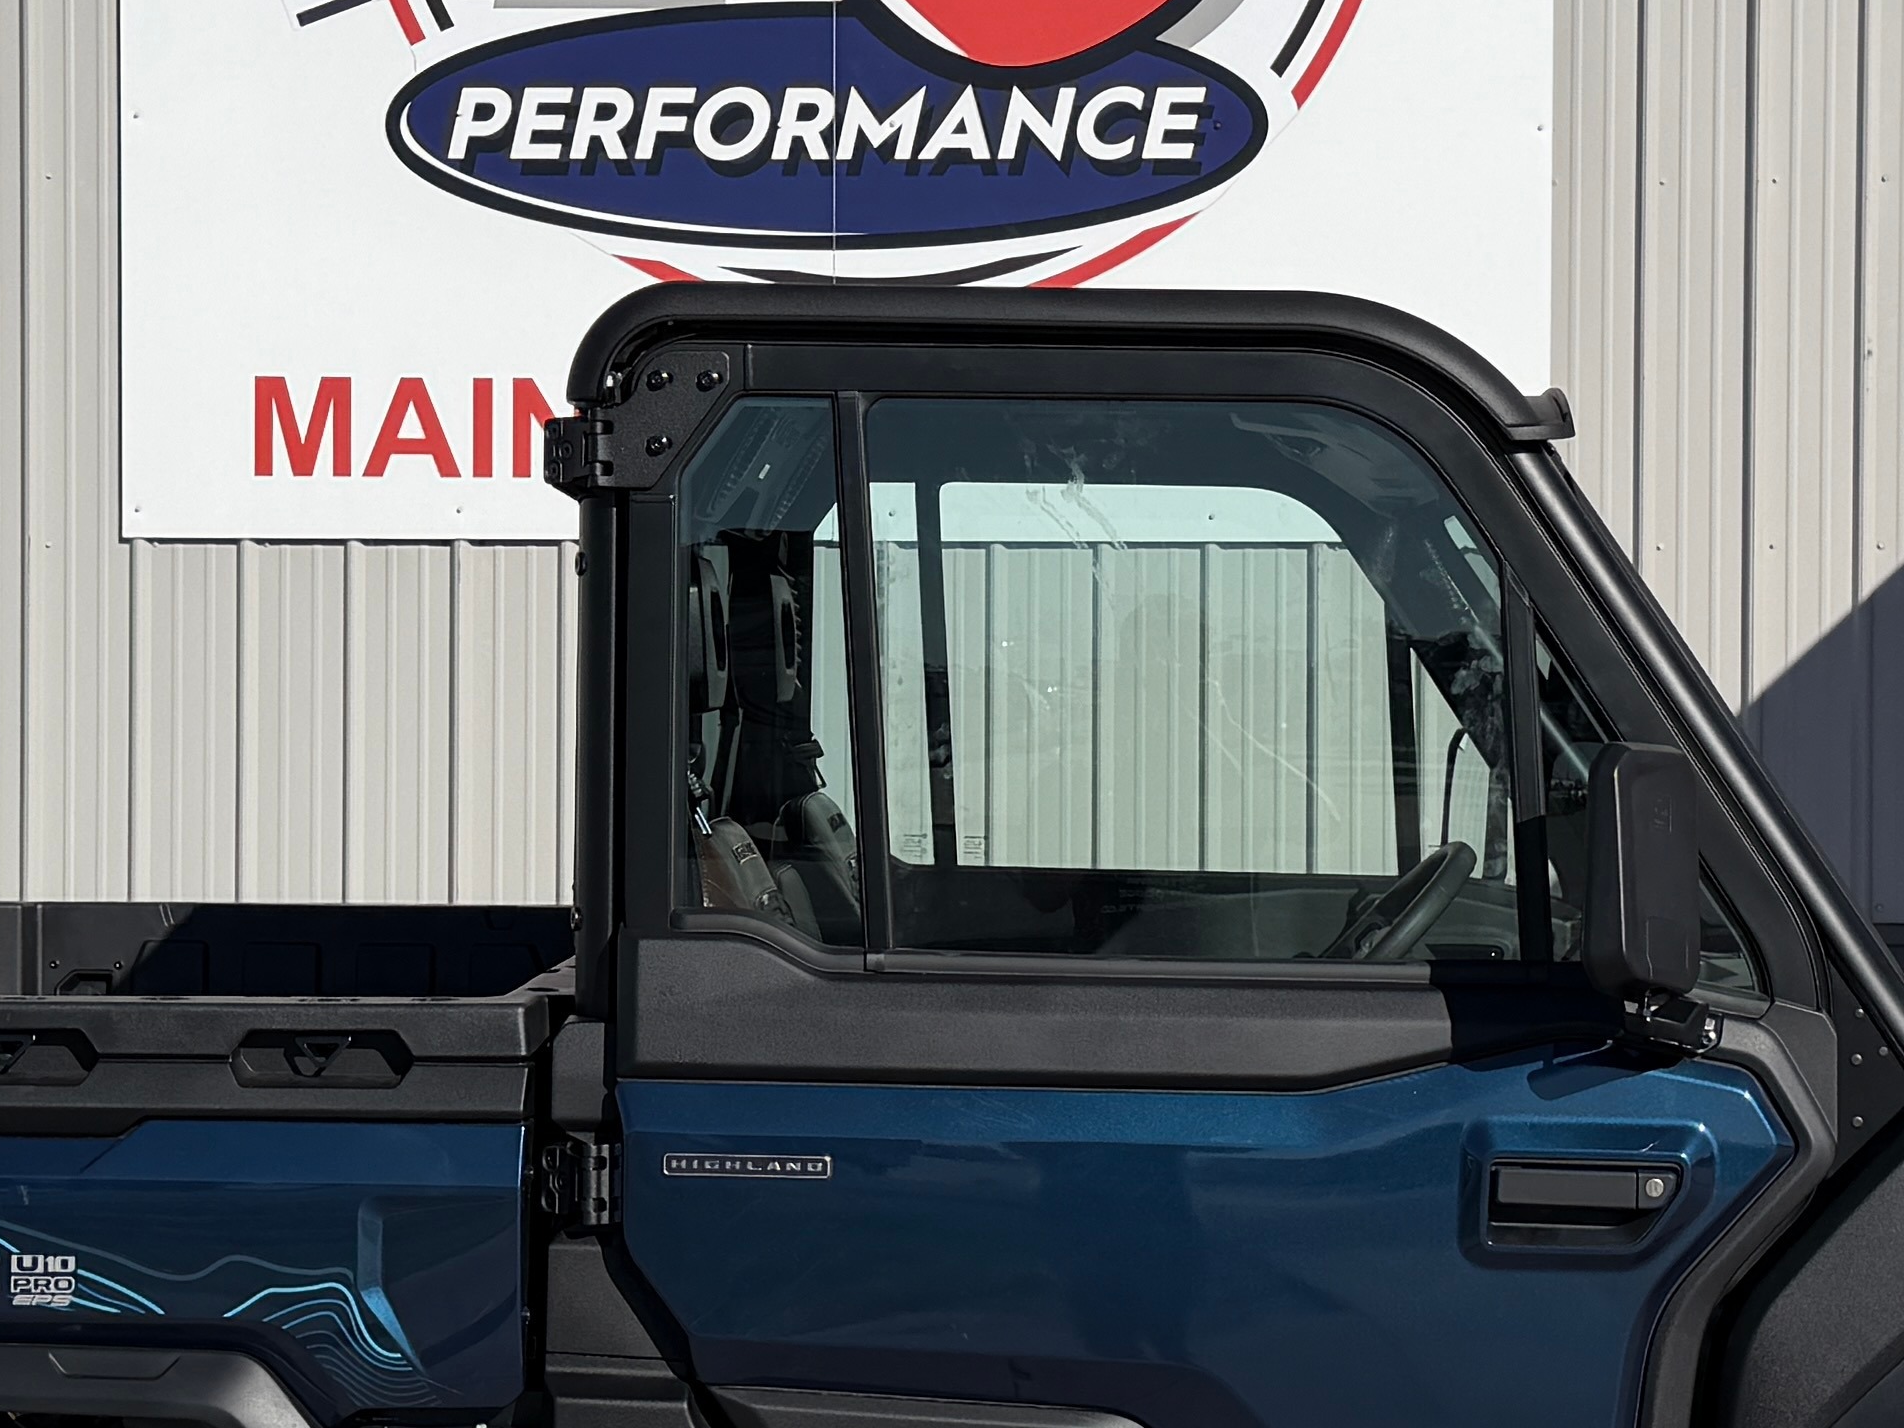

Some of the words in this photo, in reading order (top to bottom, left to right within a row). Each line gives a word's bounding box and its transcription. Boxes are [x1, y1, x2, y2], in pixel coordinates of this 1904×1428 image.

[447, 84, 1208, 161] PERFORMANCE
[670, 1158, 824, 1173] HIGHLAND
[10, 1254, 76, 1273] U10
[10, 1275, 76, 1294] PRO
[12, 1294, 74, 1307] EPS
